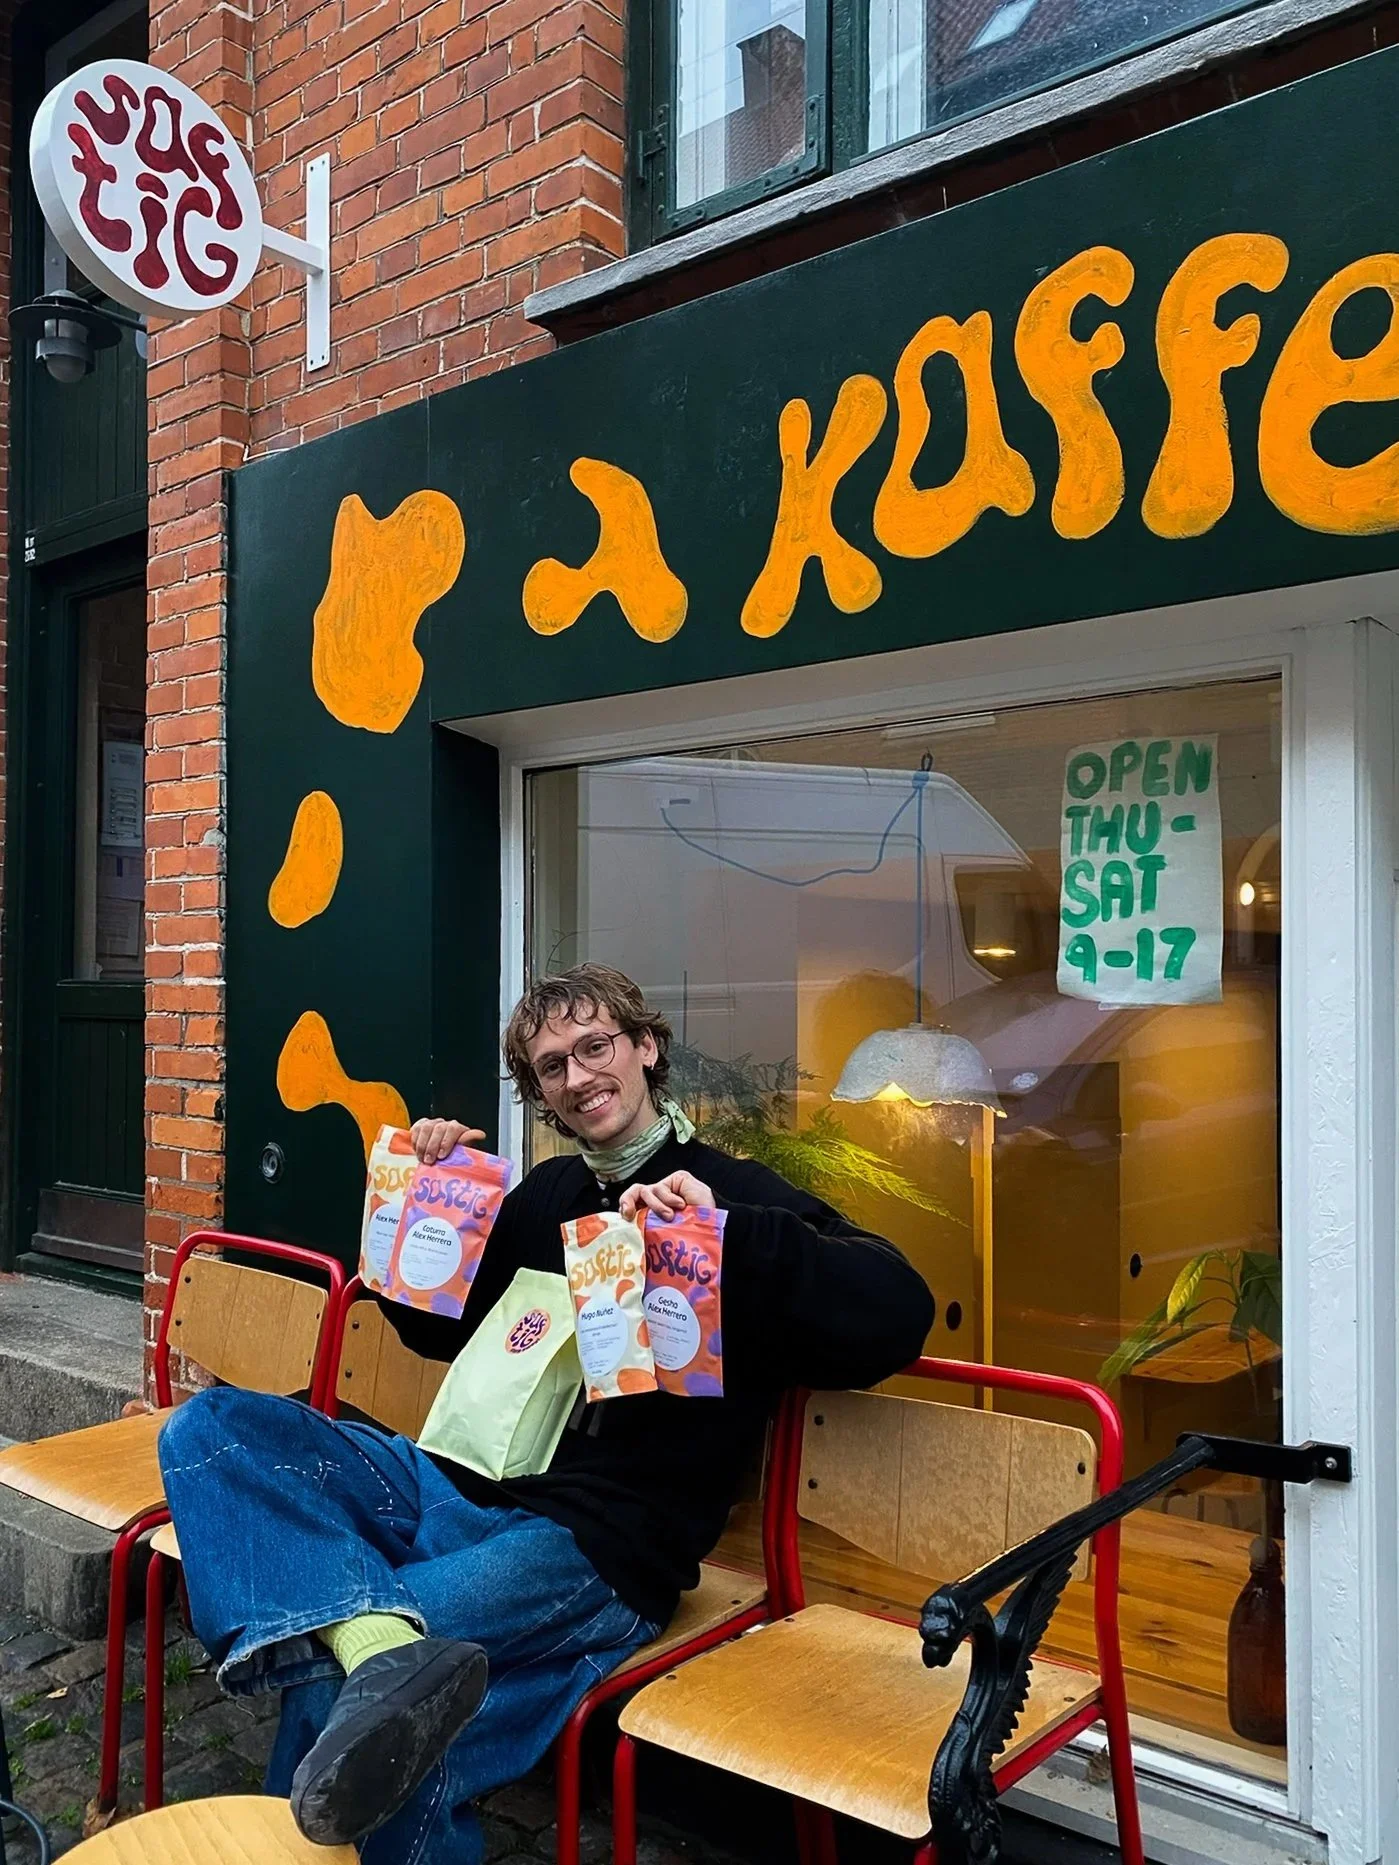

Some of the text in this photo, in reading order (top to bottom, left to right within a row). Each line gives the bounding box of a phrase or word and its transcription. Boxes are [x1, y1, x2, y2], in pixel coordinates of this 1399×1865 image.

[1066, 740, 1213, 799] OPEN
[1062, 855, 1167, 928] SAT
[1065, 927, 1196, 984] 9-17
[376, 1213, 400, 1225] Alex Her
[412, 1230, 426, 1240] Alex
[647, 1302, 662, 1314] Alex
[581, 1310, 596, 1321] Hugo
